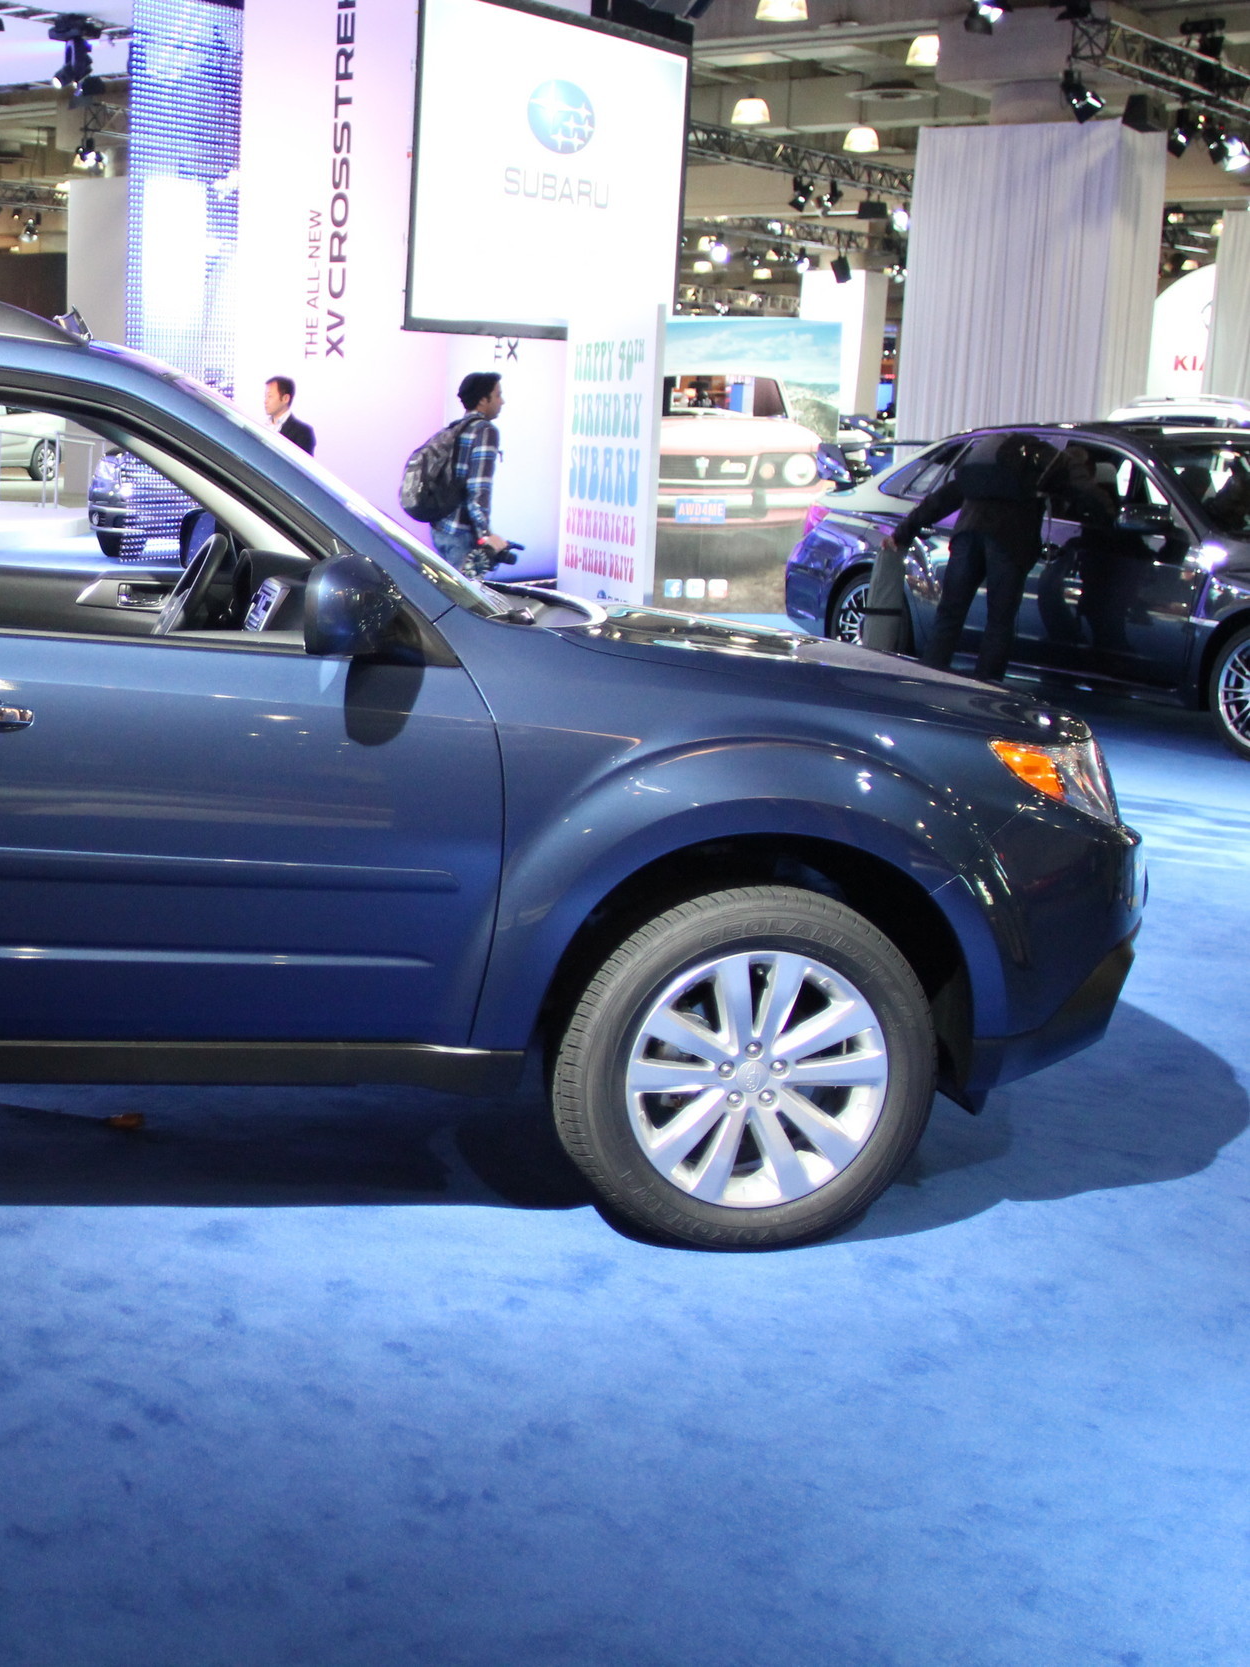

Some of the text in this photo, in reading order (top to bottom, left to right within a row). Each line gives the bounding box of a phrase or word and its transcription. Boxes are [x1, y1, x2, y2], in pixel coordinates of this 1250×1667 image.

[503, 166, 610, 209] SUBARU
[305, 209, 322, 359] THE ALL-NEW
[326, 308, 346, 358] XV
[574, 341, 615, 382] HAPPY
[571, 392, 642, 439] BIRTHDAY
[568, 444, 640, 507] SUBARU
[566, 506, 636, 547] SYMMETRICAL
[678, 502, 725, 517] AWD4ME
[564, 543, 635, 583] ALL-WHEEL DRIVE
